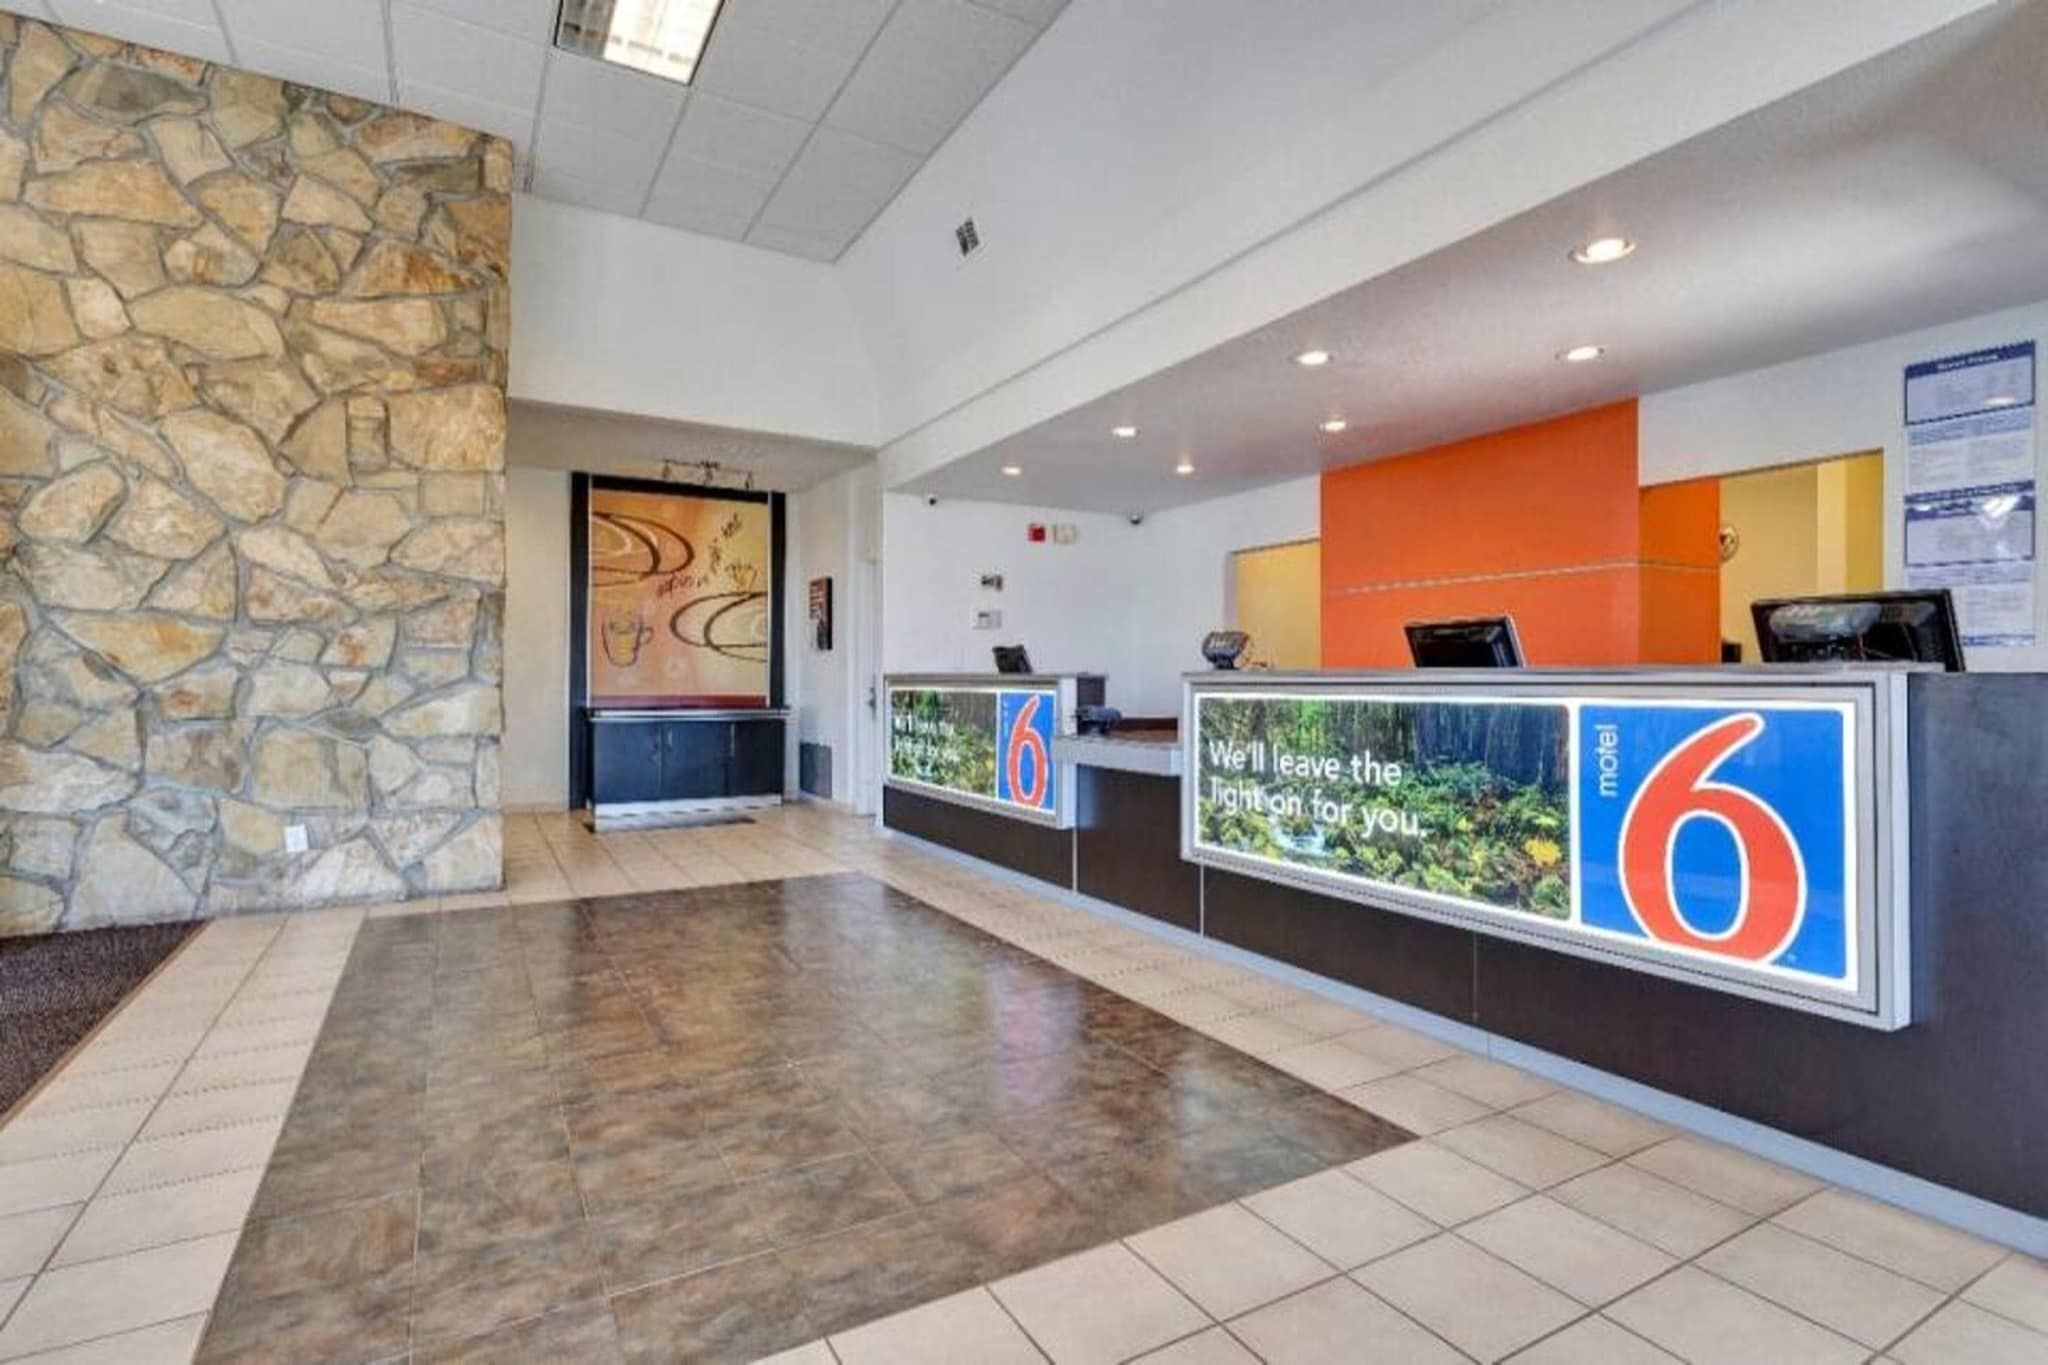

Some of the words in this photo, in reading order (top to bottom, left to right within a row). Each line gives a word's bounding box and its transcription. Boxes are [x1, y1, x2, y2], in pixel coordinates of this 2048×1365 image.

[1008, 693, 1048, 809] 6
[1209, 738, 1265, 772] We'll
[1273, 743, 1340, 780] leave
[1350, 750, 1402, 786] the
[1594, 724, 1619, 797] motel
[1211, 775, 1265, 816] light
[1270, 791, 1302, 817] on
[1312, 788, 1352, 826] for
[1361, 805, 1429, 838] you.
[1618, 712, 1808, 965] 6
